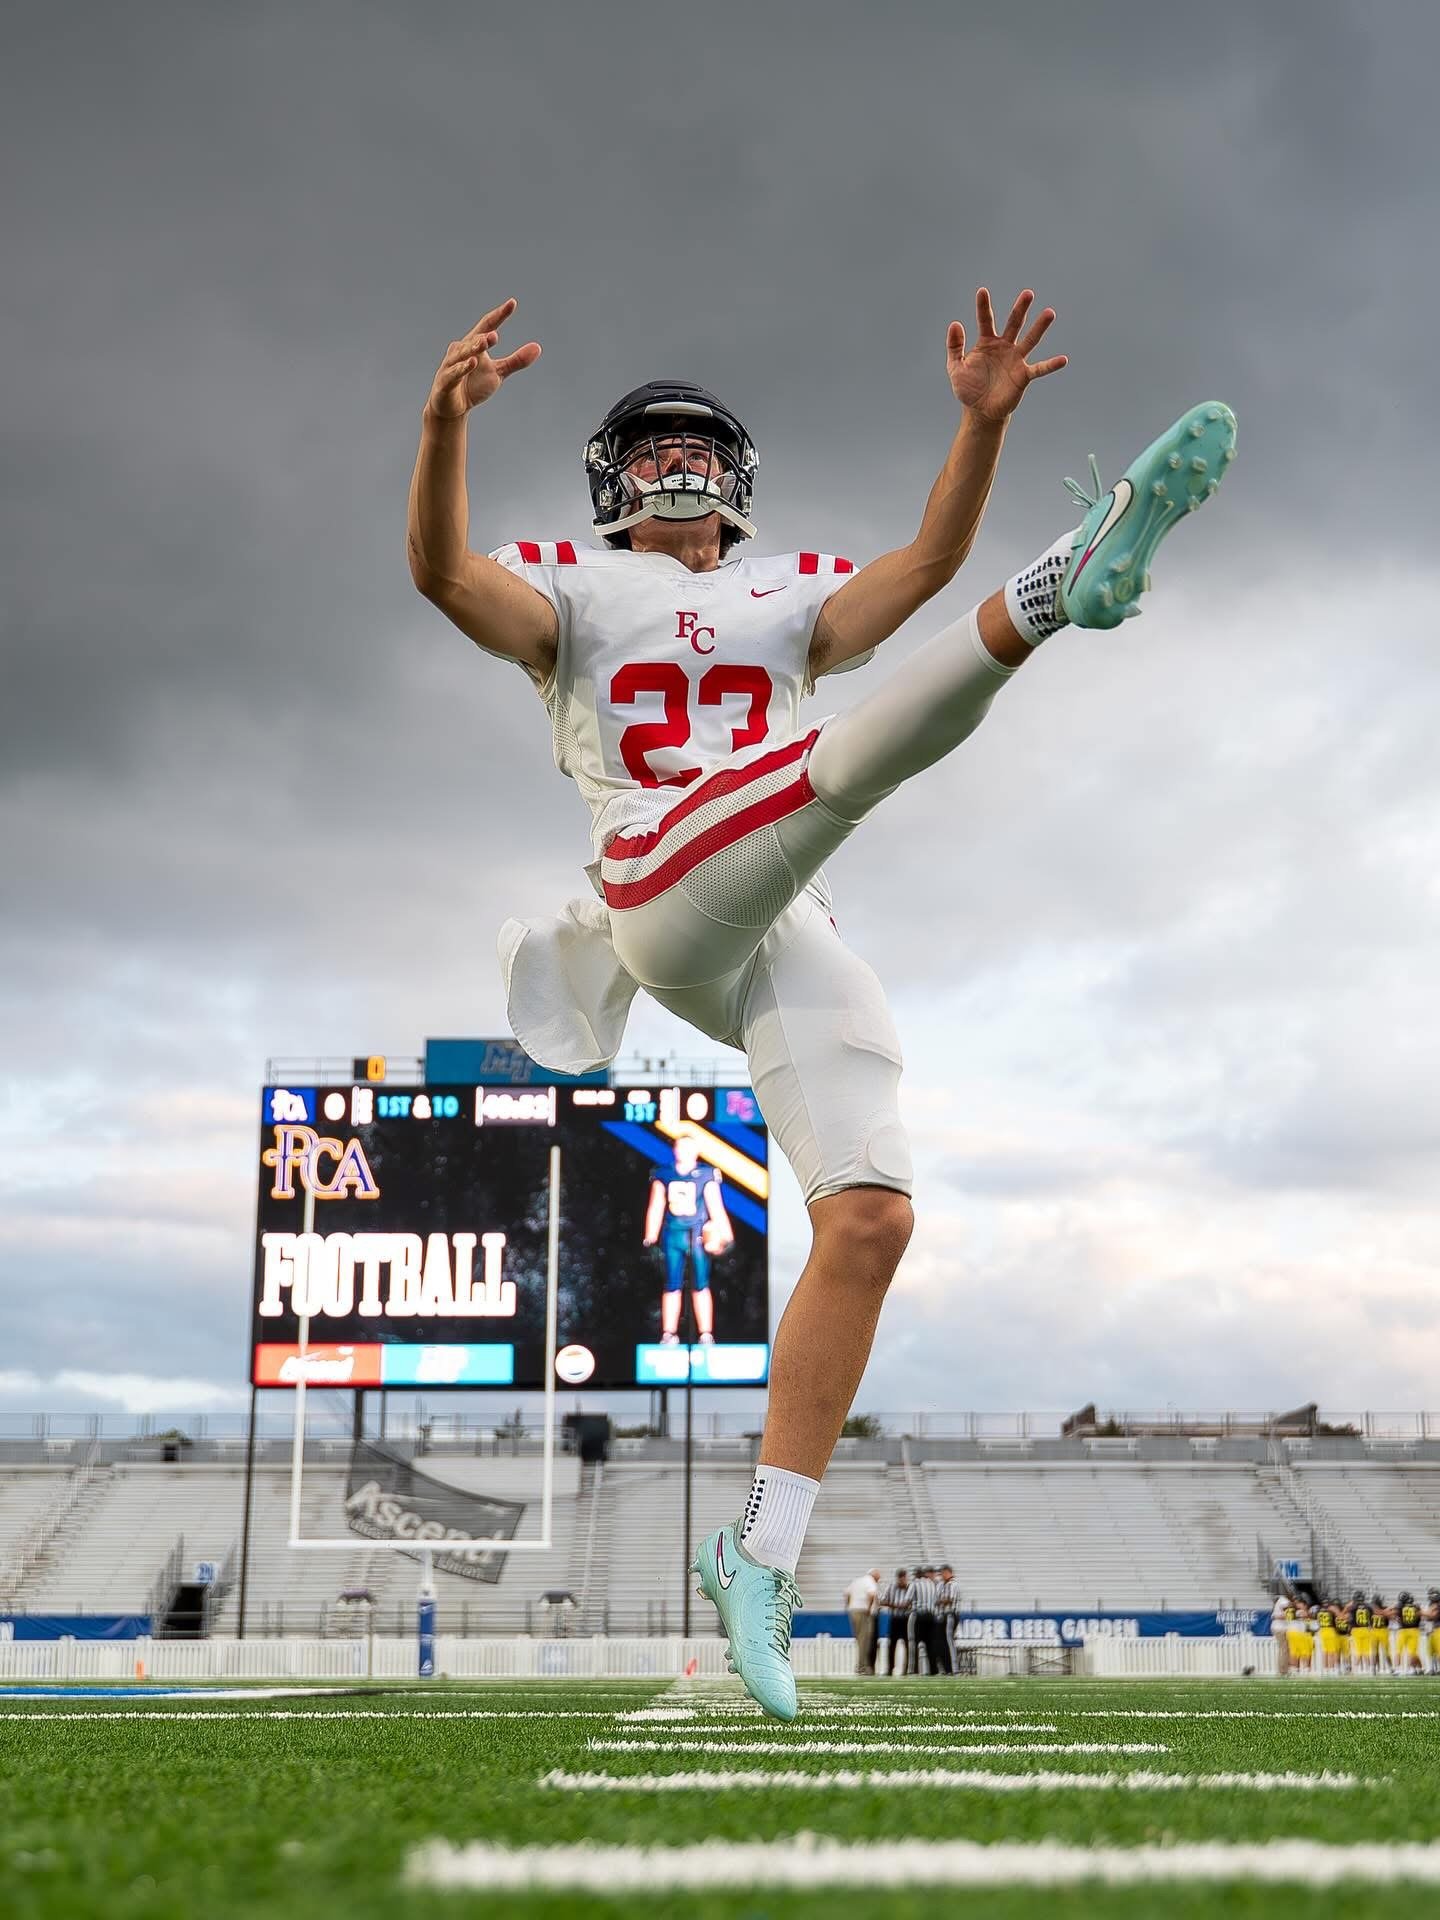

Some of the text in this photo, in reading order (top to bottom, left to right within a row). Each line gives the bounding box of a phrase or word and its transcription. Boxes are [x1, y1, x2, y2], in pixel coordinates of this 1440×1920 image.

[675, 611, 716, 655] FC
[610, 662, 773, 789] 23
[377, 1096, 411, 1117] 1ST
[412, 1094, 431, 1119] &
[432, 1096, 459, 1117] 10
[262, 1125, 380, 1199] PCA
[259, 1232, 516, 1317] FOOTBALL
[954, 1619, 1139, 1640] AIDER BEER GARDEN
